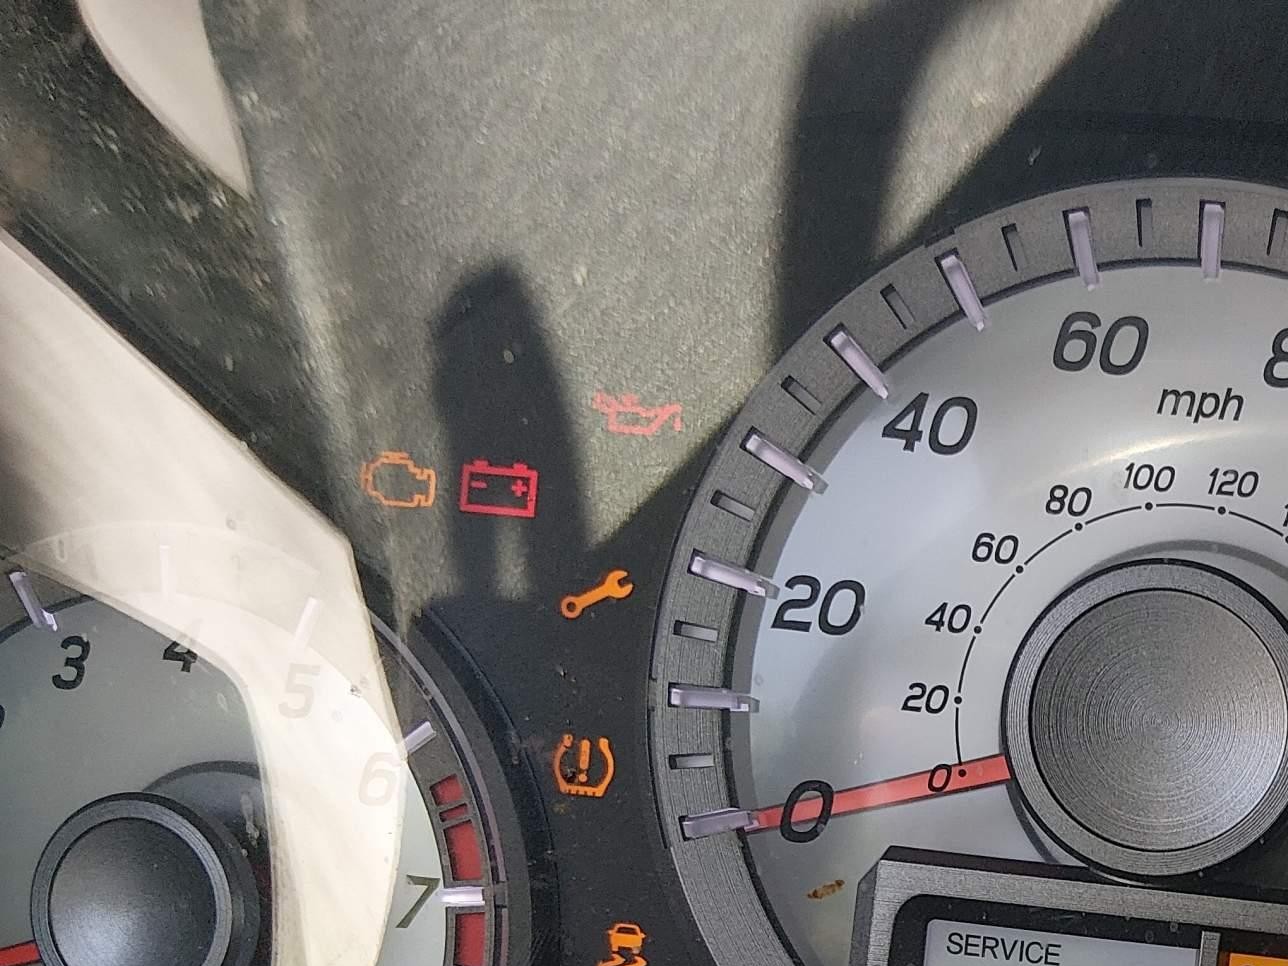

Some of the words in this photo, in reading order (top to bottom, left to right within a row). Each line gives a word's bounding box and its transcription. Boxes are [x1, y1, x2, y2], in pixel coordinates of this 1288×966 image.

[1053, 312, 1149, 375] 60
[1157, 387, 1244, 423] mph
[882, 392, 977, 455] 40
[1123, 463, 1175, 493] 100
[1207, 469, 1258, 498] 120
[1045, 484, 1091, 516] 80
[971, 532, 1019, 564] 60
[772, 575, 866, 635] 20
[925, 604, 972, 633] 40
[51, 635, 92, 690] 3
[902, 682, 949, 714] 20
[927, 763, 952, 793] 0
[780, 780, 834, 843] 0
[396, 874, 441, 929] 7
[946, 932, 1061, 966] SERVICE
